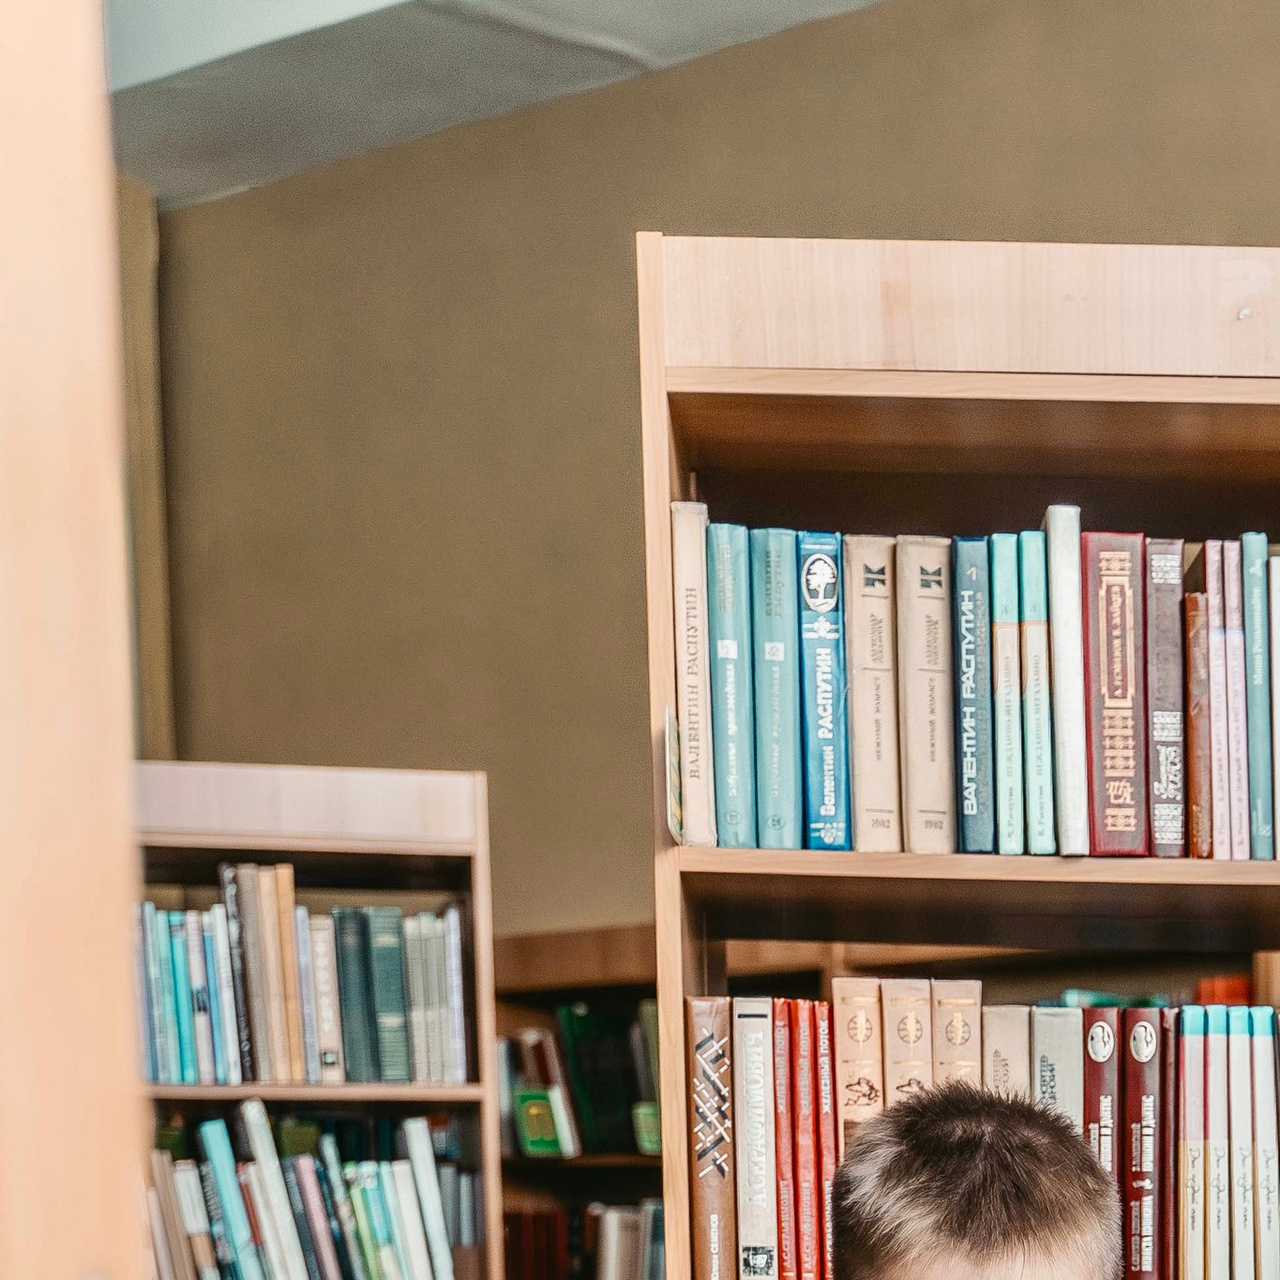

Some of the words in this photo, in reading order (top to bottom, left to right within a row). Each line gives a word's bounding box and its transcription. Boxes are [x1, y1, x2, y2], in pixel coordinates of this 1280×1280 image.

[684, 587, 699, 676] РАСПУТИН
[959, 591, 976, 699] РАСПУТИН
[817, 648, 834, 740] РАСПУТИН
[687, 684, 701, 778] ВАЛЕНТИН
[961, 707, 978, 816] ВАЛЕНТИН
[820, 746, 836, 816] Валентин
[775, 1020, 786, 1053] ПОТОК
[799, 1021, 809, 1054] ПОТОК
[819, 1019, 830, 1053] ПОТОК
[743, 1031, 768, 1208] А.СЕРАФИМОВИЧ
[777, 1057, 787, 1113] ЖЕЛЕЗНЫЙ
[800, 1059, 810, 1115] ЖЕЛЕЗНЫЙ
[820, 1056, 831, 1114] ЖЕЛЕЗНЫЙ
